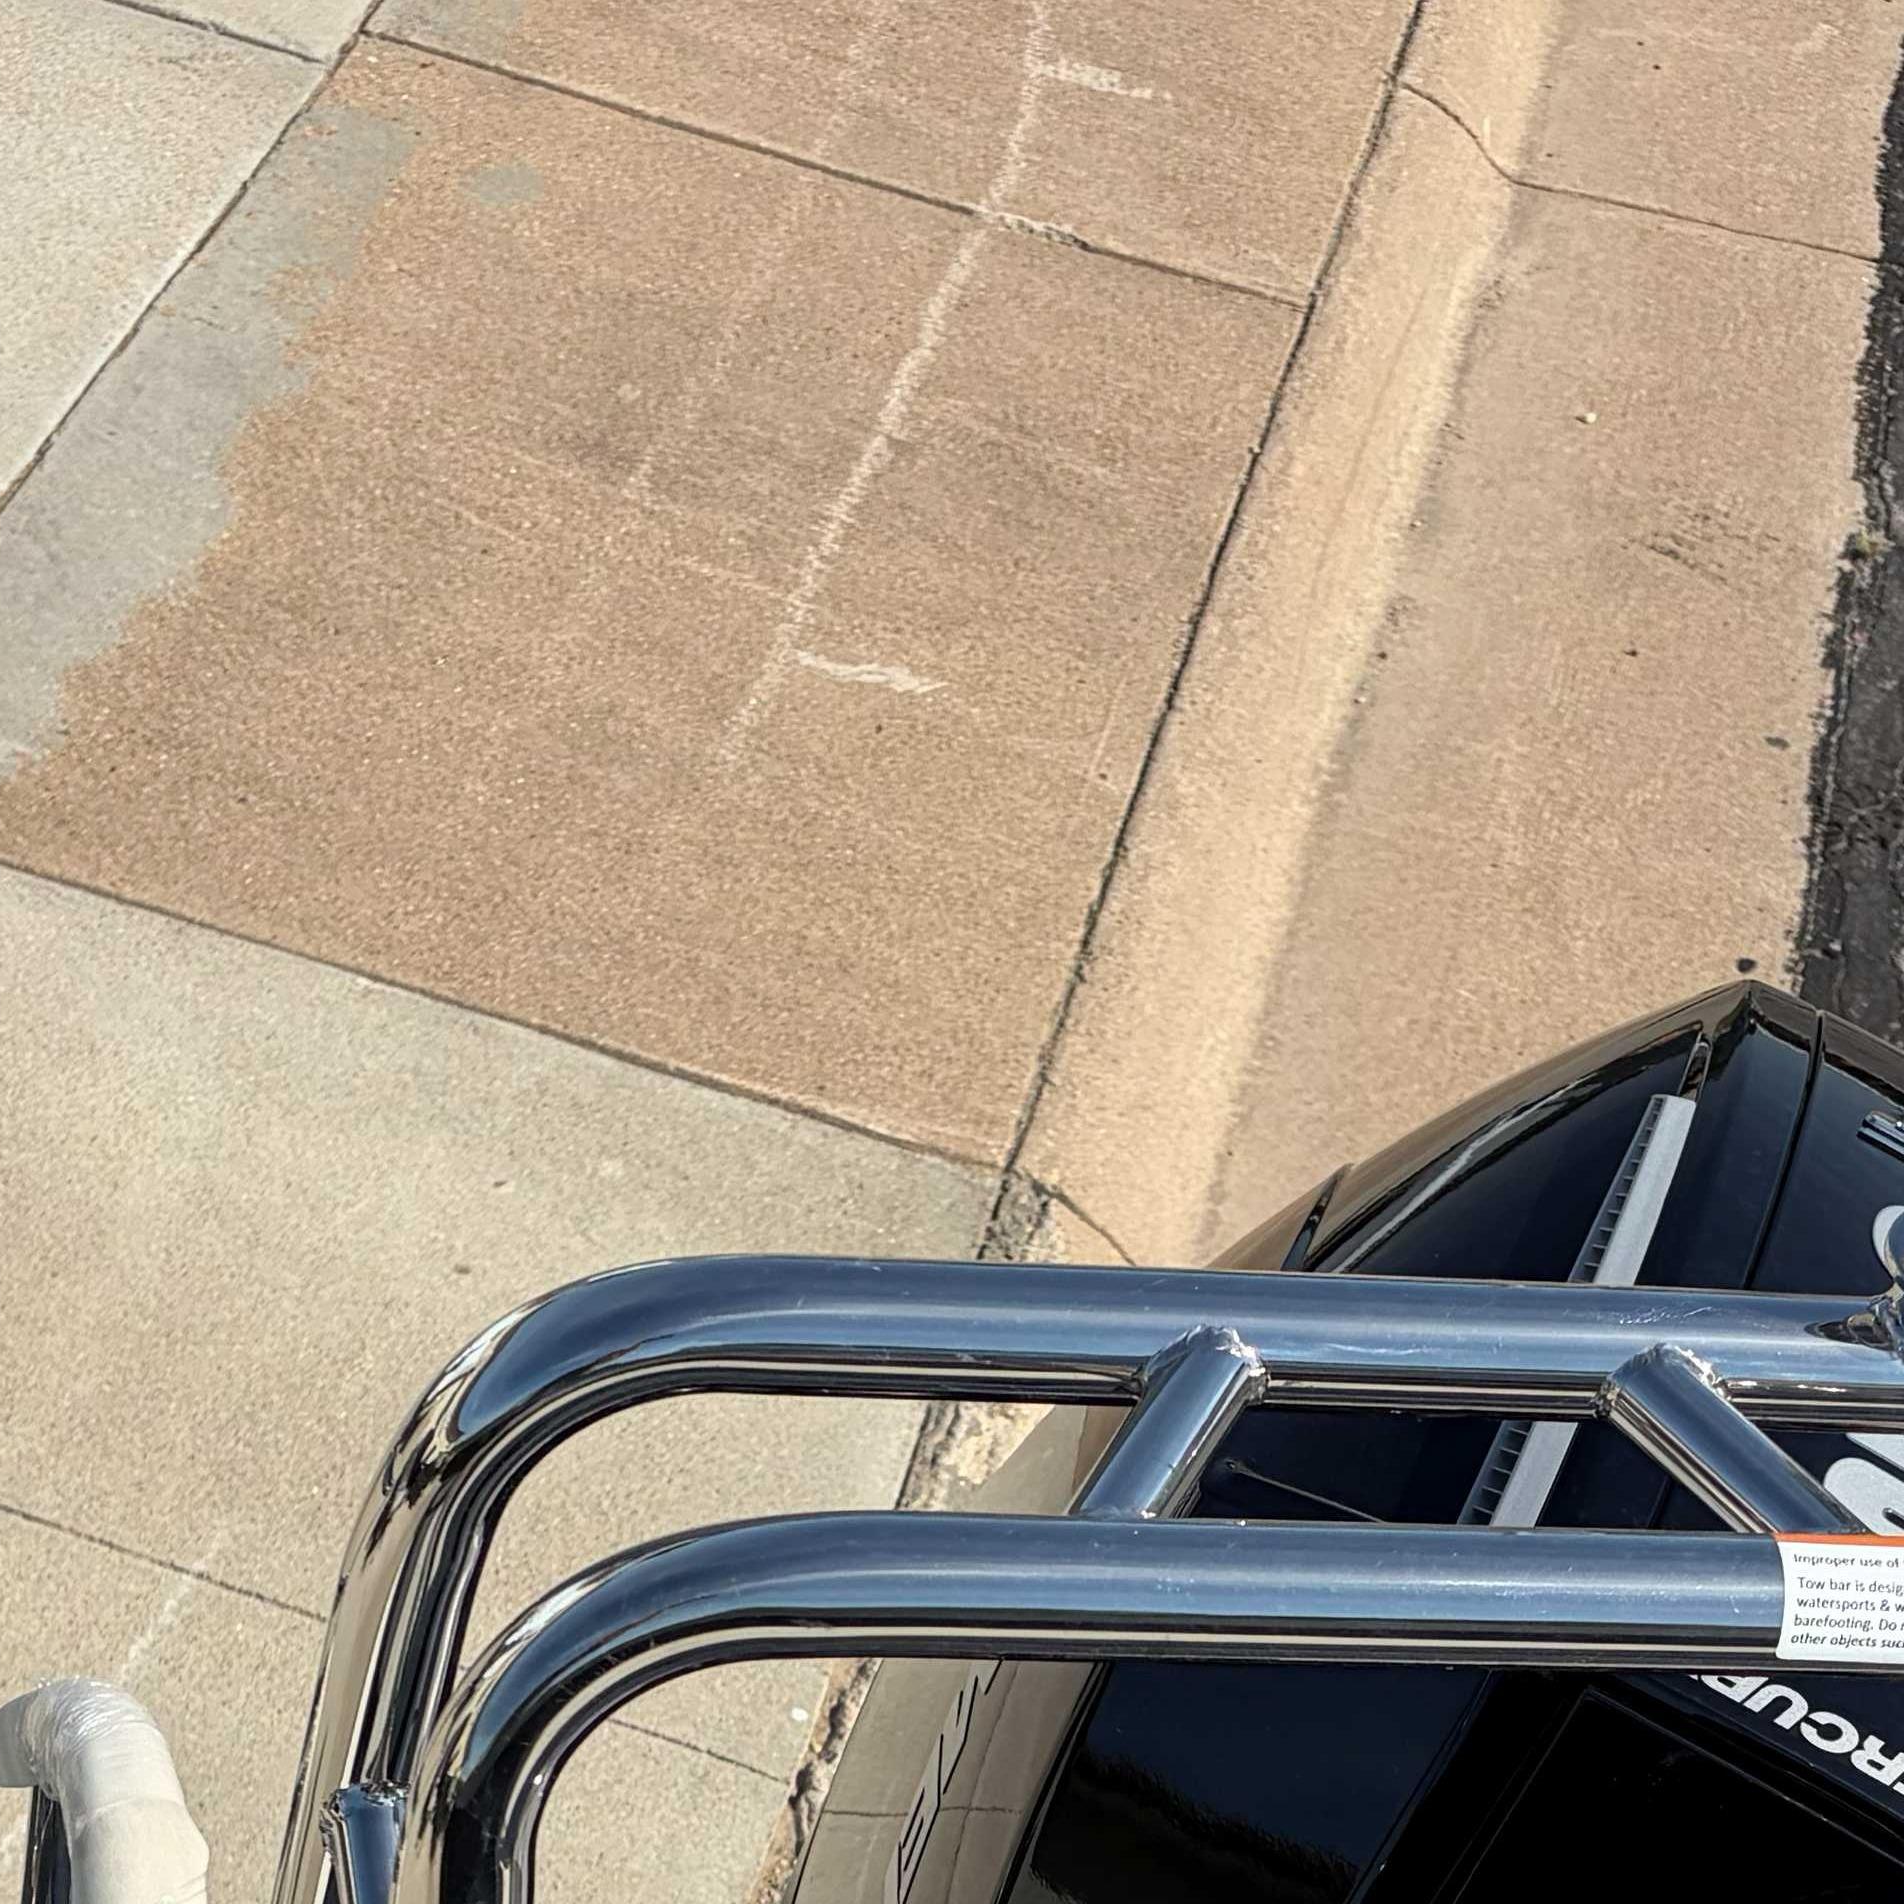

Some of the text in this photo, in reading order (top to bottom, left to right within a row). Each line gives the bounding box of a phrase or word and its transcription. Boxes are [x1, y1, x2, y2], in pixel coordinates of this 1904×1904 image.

[1794, 1553, 1855, 1566] Improper
[1860, 1558, 1882, 1568] use
[1887, 1558, 1898, 1568] of
[1797, 1576, 1825, 1589] Tow
[1830, 1578, 1851, 1591] bar
[1856, 1580, 1865, 1592] is
[1797, 1597, 1876, 1612] watersports
[1880, 1599, 1890, 1612] &
[1794, 1614, 1874, 1632] barefooting.
[1879, 1619, 1897, 1631] Do
[1791, 1633, 1827, 1645] other
[1830, 1634, 1877, 1648] objects
